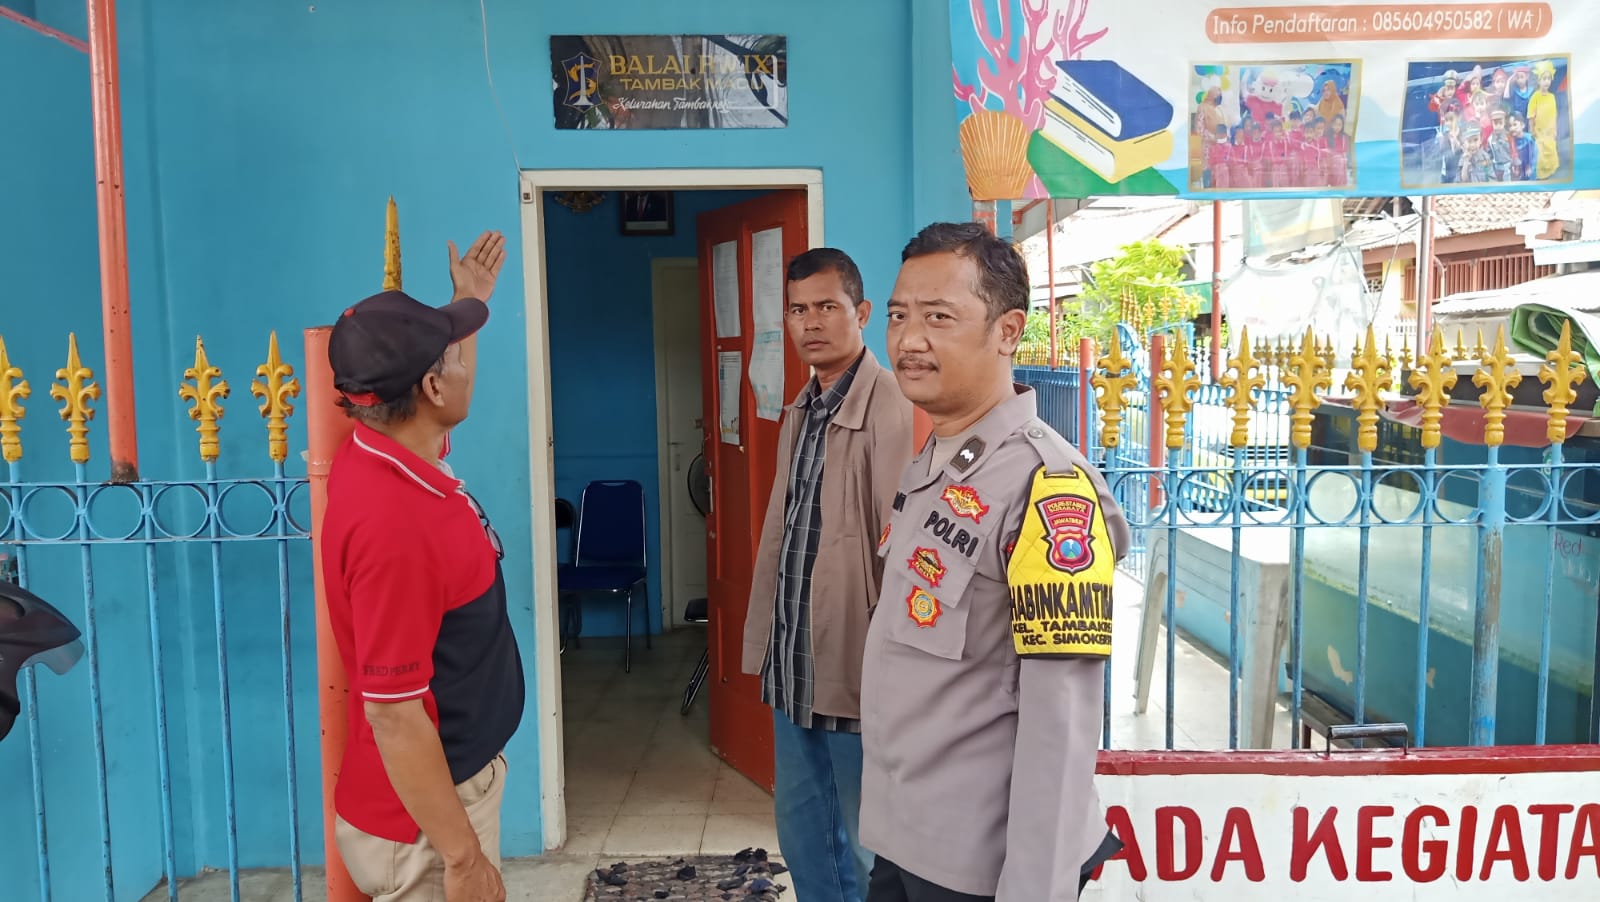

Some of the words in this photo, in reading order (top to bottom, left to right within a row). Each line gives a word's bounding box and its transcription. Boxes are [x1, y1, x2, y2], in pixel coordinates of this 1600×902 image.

[1212, 15, 1247, 35] Info
[1252, 12, 1357, 34] Pendaftaran
[1372, 10, 1493, 32] 085604950582
[609, 55, 691, 75] BALAI
[619, 78, 702, 91] TAMBAK
[612, 97, 671, 111] Kelurahan
[923, 510, 979, 558] POLRI
[1013, 622, 1034, 633] KEL.
[1022, 633, 1047, 646] KEC.
[1089, 805, 1266, 882] ADA
